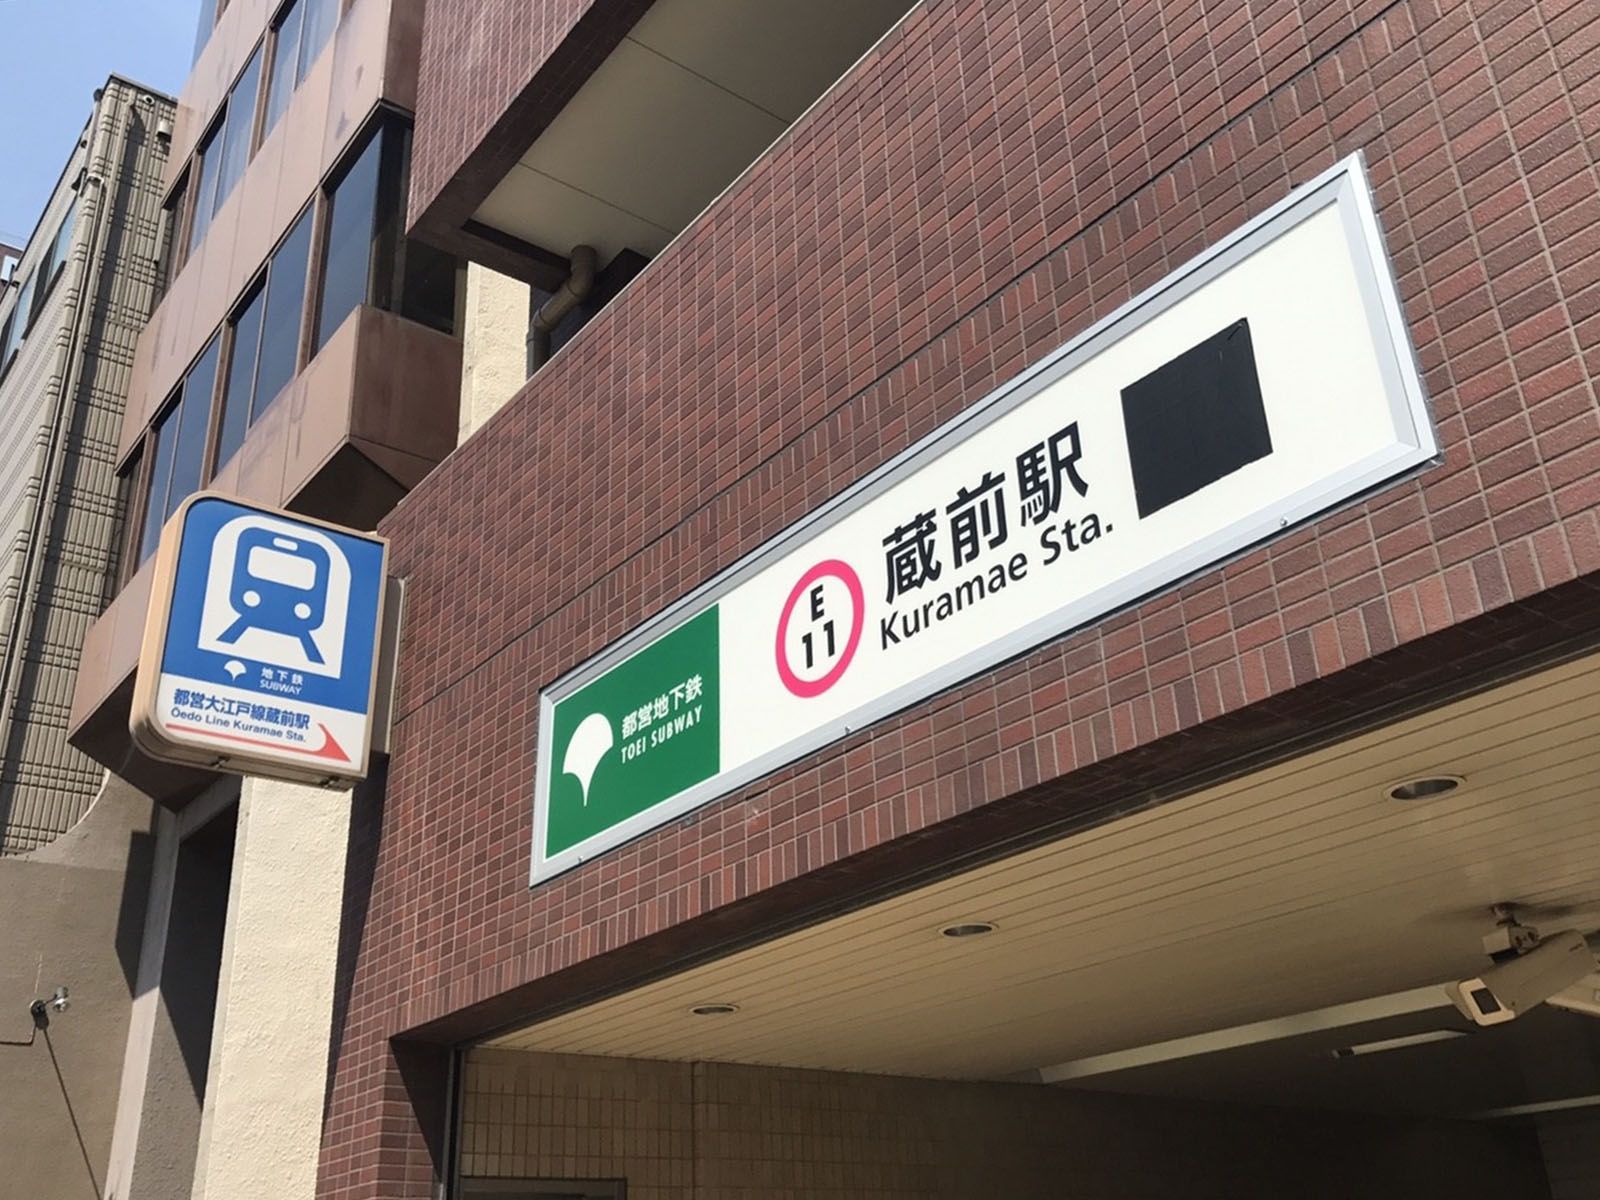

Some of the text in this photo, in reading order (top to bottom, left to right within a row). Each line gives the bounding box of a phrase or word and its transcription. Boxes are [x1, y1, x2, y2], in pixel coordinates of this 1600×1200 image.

[882, 421, 1088, 605] 蔵前駅
[810, 584, 825, 622] E
[880, 513, 1113, 650] Kuramae Sta.
[801, 620, 835, 669] 11
[259, 679, 302, 695] SUBWAY
[260, 667, 303, 685] 地下鉄
[173, 689, 310, 730] 都営大江戸線蔵前駅
[205, 714, 230, 728] Line
[233, 719, 283, 739] Kuramae
[285, 729, 306, 743] Sta.
[621, 674, 703, 740] 都営地下鉄
[621, 705, 703, 763] TOEI SUBWAY
